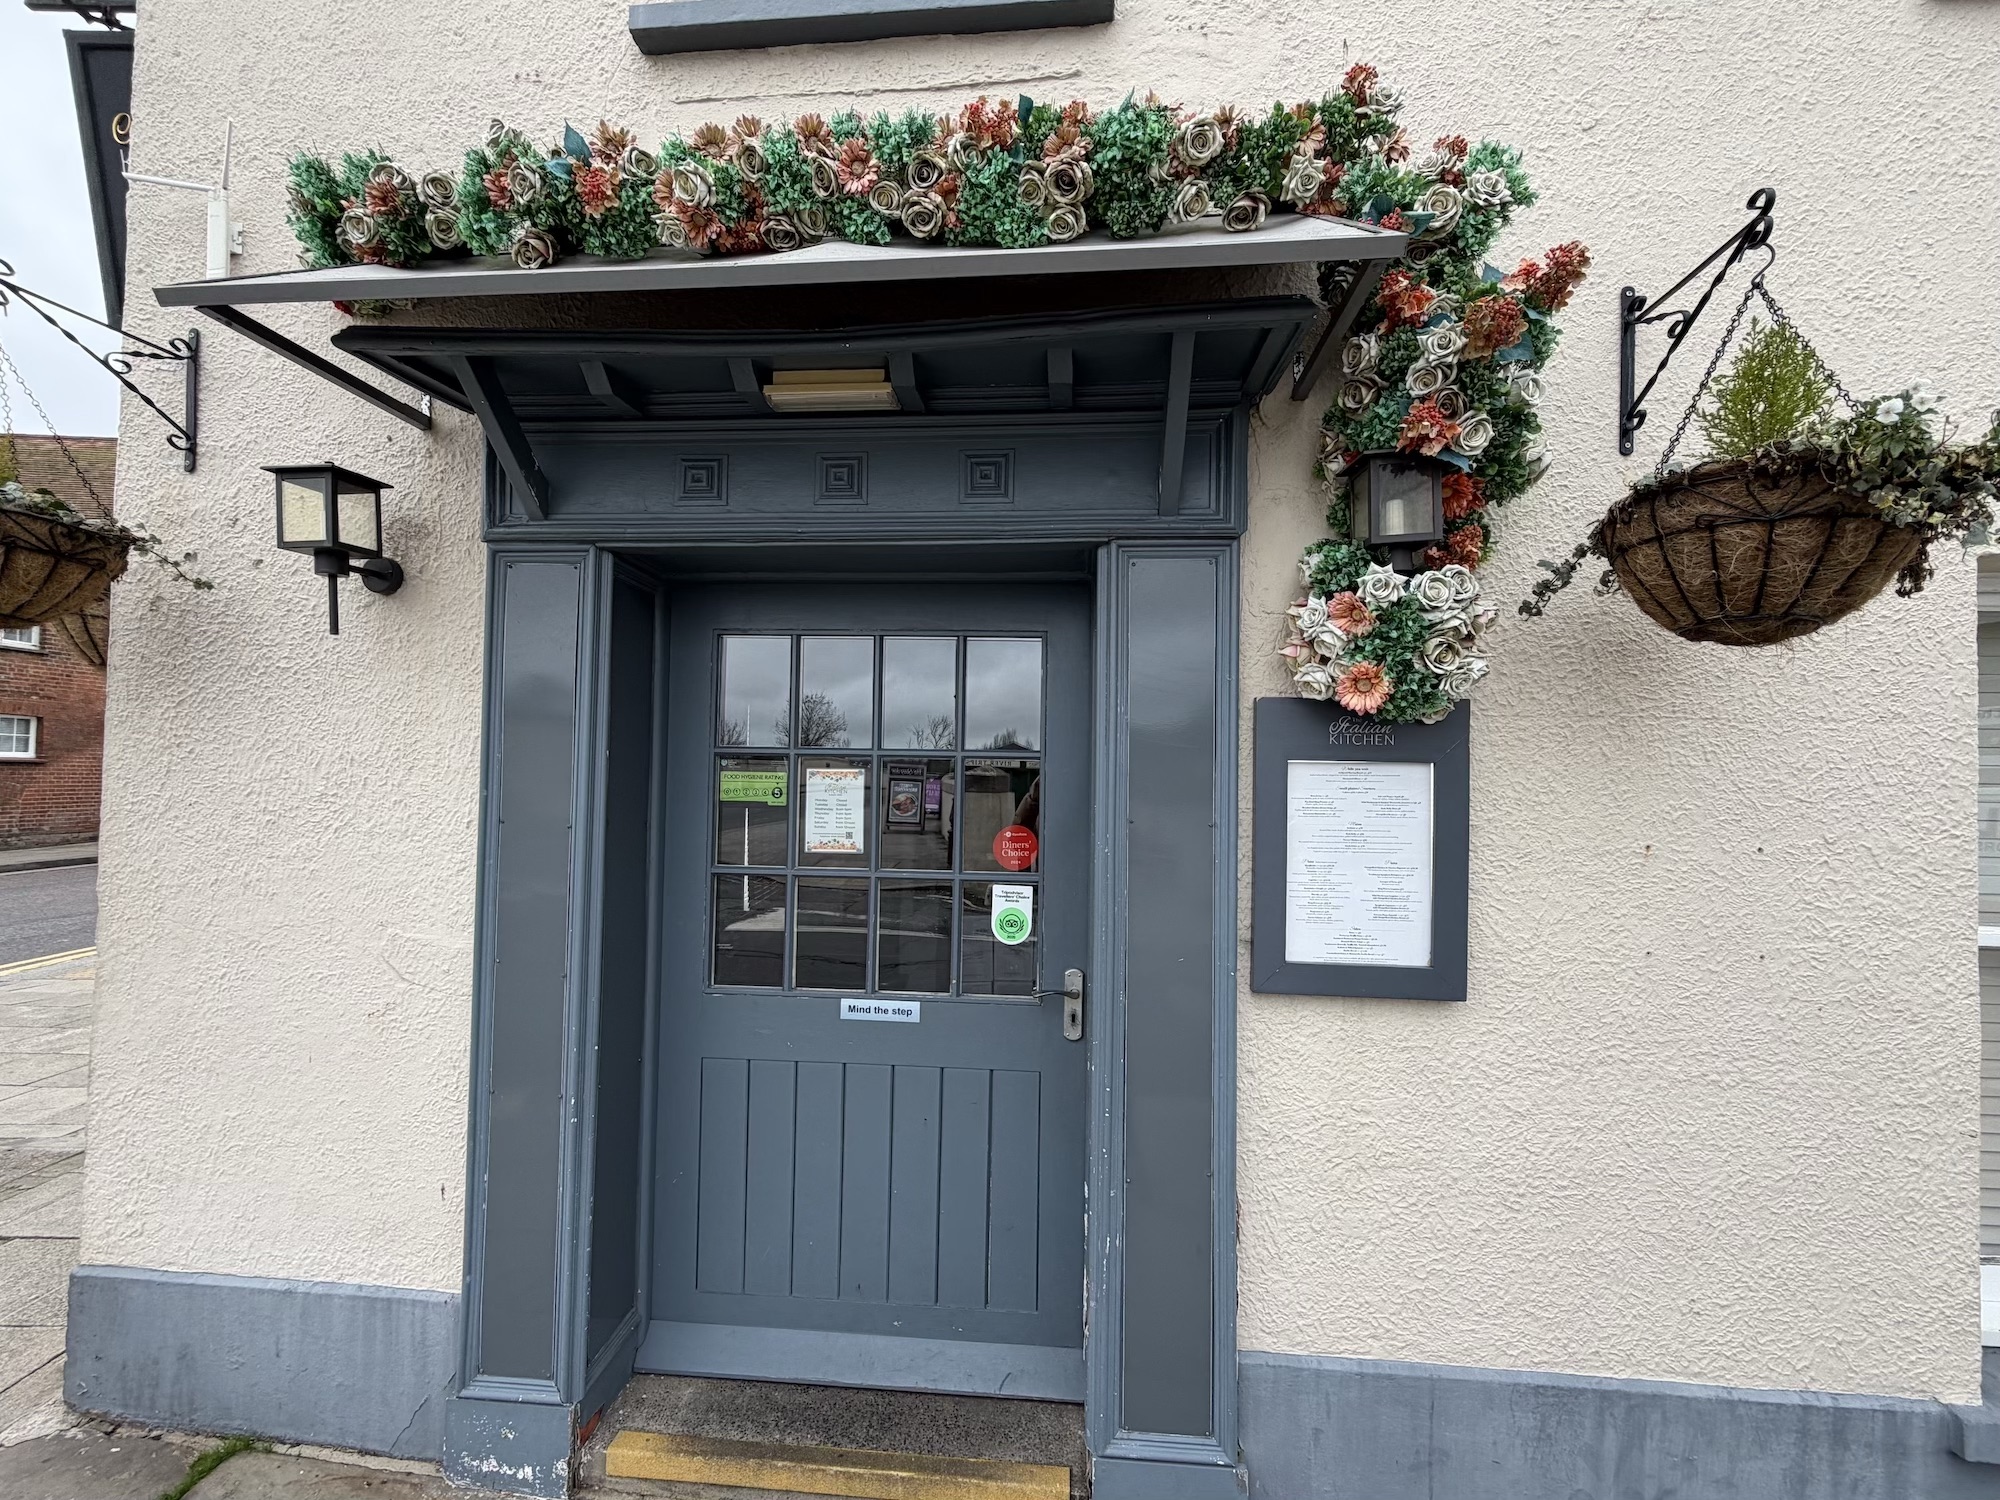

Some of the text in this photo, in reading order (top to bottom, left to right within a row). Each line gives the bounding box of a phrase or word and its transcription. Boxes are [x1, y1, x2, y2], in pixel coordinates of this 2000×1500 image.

[1329, 716, 1393, 734] Italian
[1002, 849, 1029, 857] Choice
[848, 1005, 912, 1017] Mind the step
